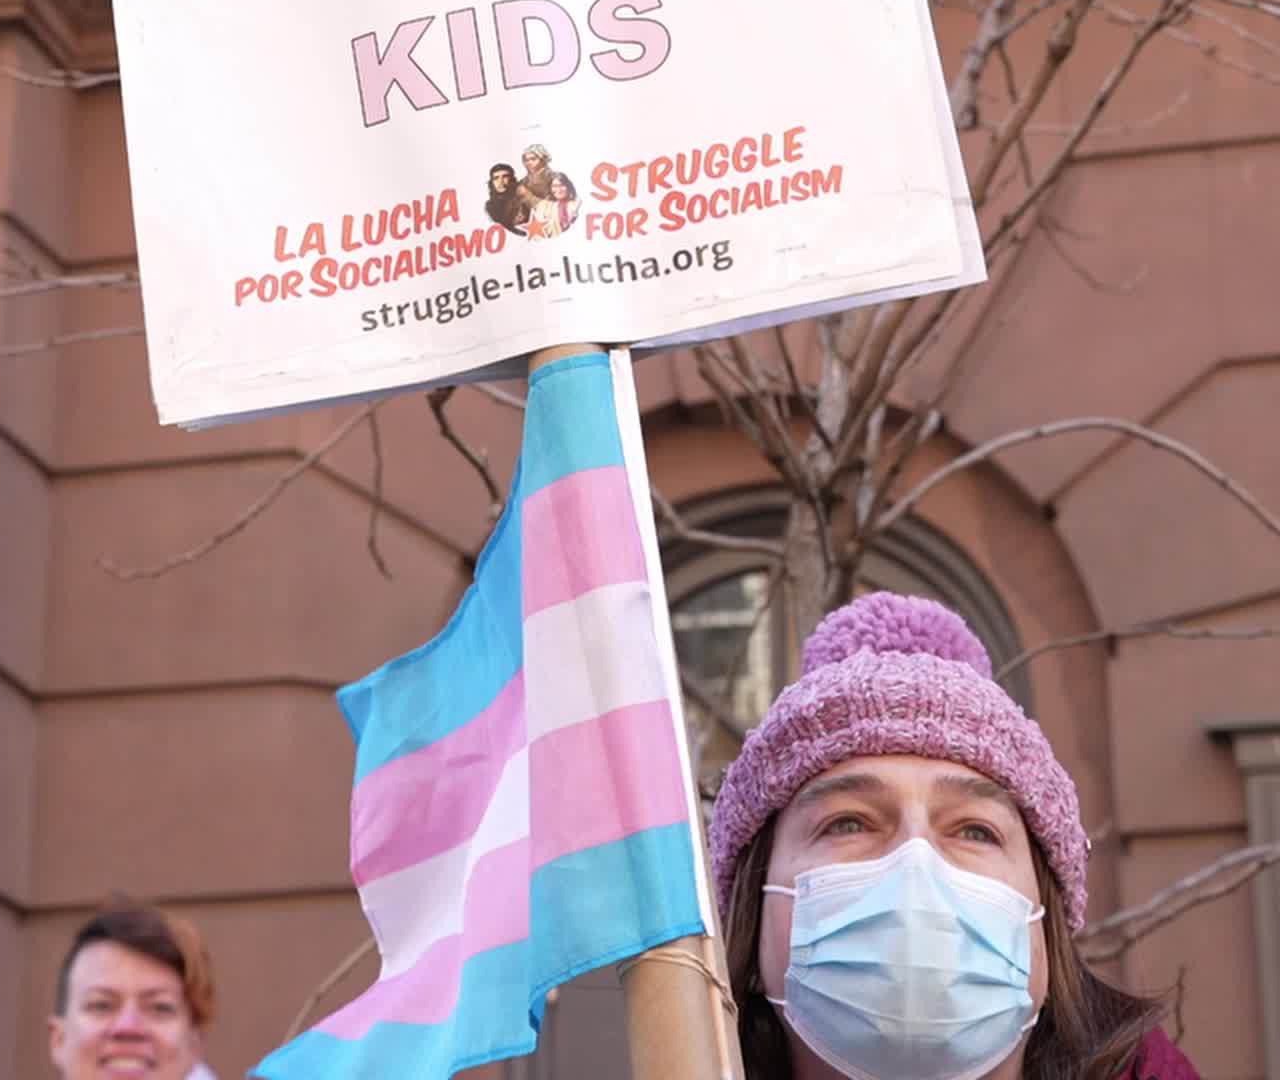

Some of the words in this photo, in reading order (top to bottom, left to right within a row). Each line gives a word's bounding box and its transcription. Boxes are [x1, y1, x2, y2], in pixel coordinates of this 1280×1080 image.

[590, 126, 806, 202] STRUGGLE
[274, 223, 326, 262] LA
[341, 188, 460, 253] LUCHA
[585, 208, 649, 241] FOR
[659, 165, 843, 232] SOCIALISM
[234, 270, 304, 307] POR
[309, 224, 507, 298] SOCIALISMO
[361, 239, 734, 332] struggle-la-lucha.org
